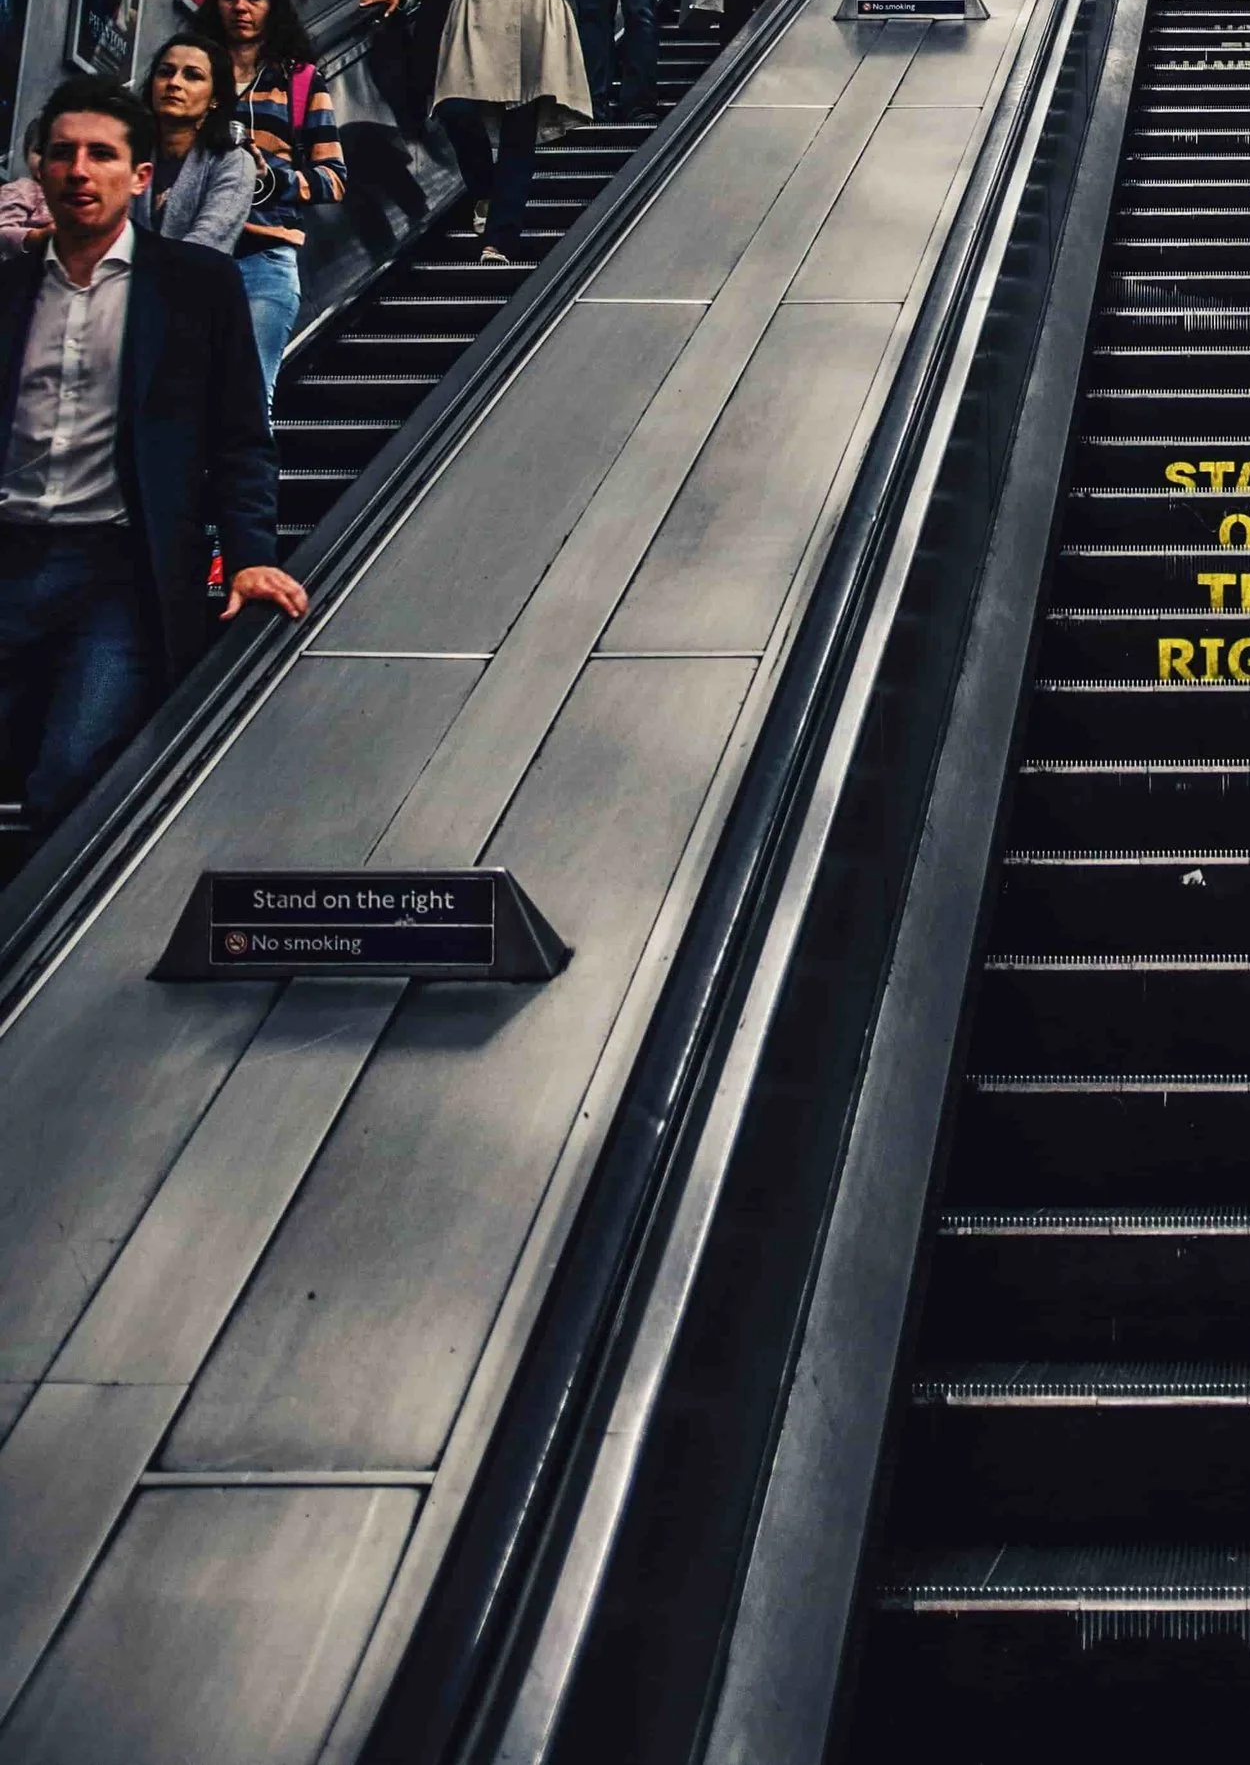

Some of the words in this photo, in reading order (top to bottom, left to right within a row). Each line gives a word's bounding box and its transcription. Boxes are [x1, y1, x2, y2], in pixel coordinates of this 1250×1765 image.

[885, 3, 916, 12] smoking
[253, 889, 316, 909] Stand
[322, 894, 350, 909] on
[355, 889, 395, 909] the
[401, 889, 455, 913] right
[252, 935, 278, 951] No
[284, 934, 362, 955] smoking
